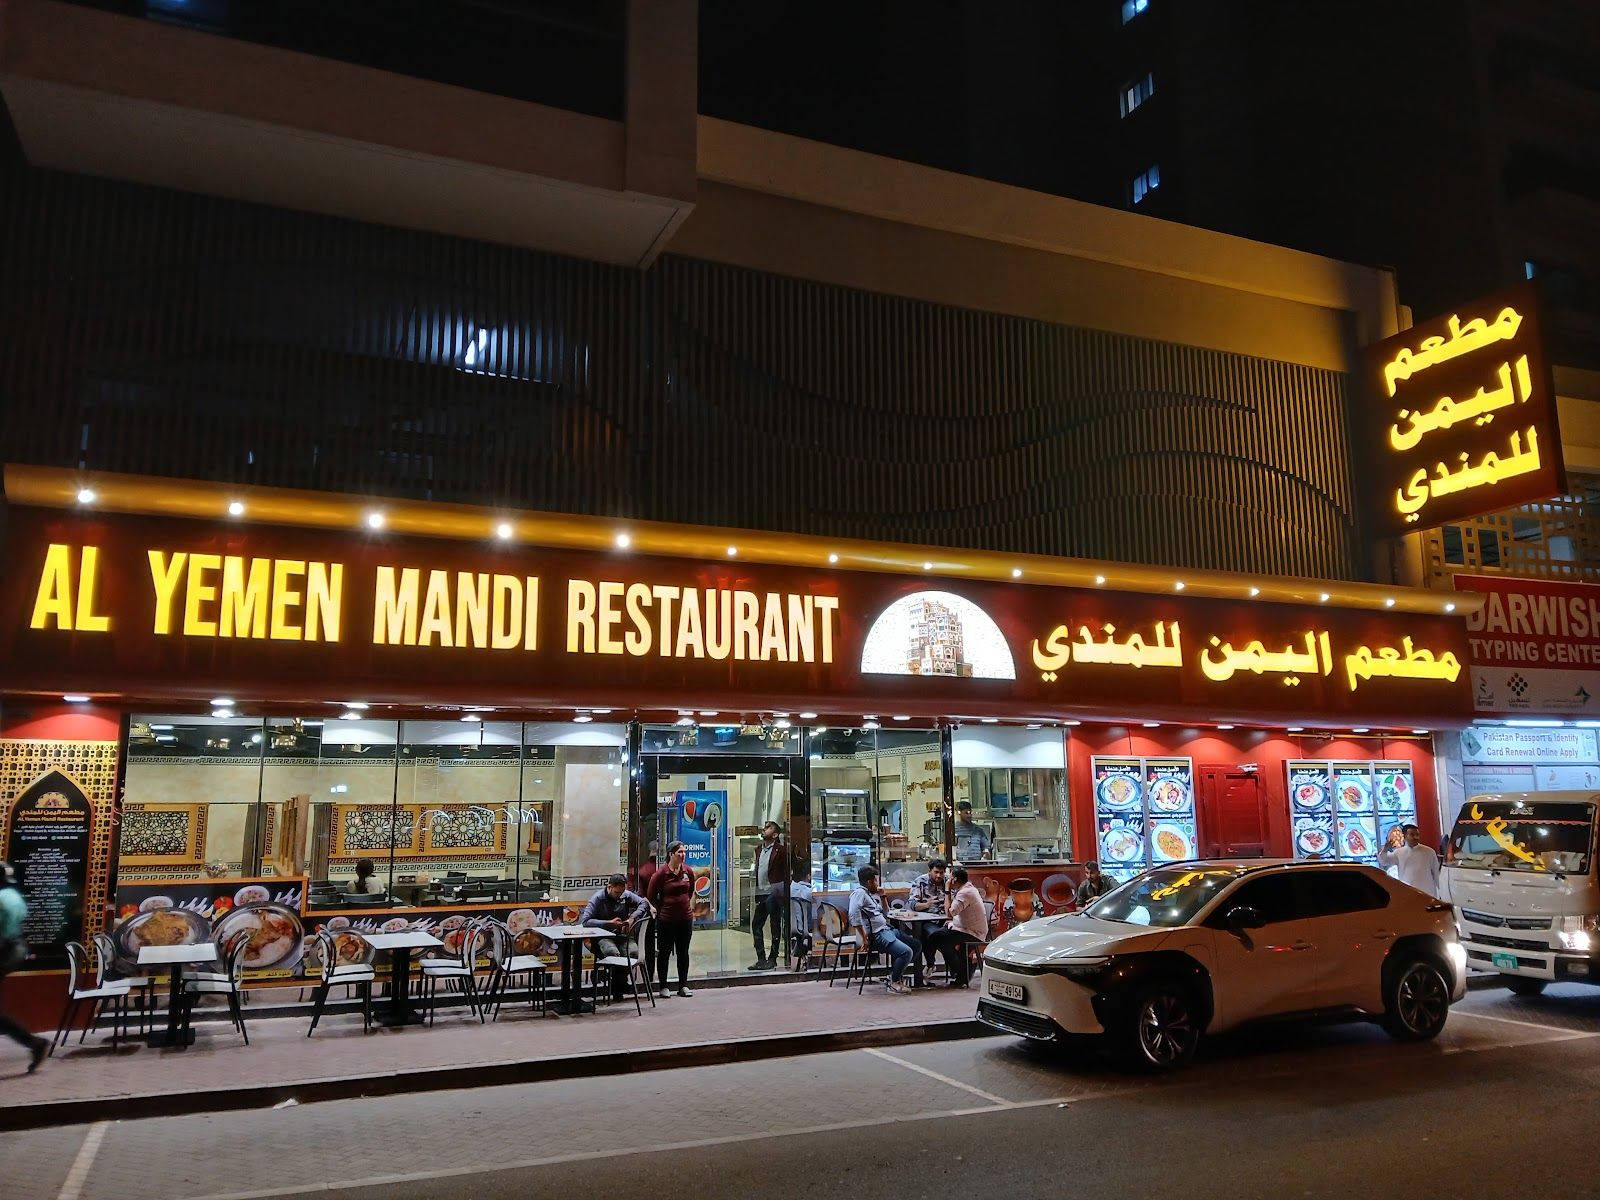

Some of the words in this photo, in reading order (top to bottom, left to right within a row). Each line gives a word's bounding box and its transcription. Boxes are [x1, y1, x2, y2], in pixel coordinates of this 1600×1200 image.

[1385, 307, 1523, 397] مطعم
[1390, 355, 1532, 451] اليمن
[1396, 425, 1541, 522] للمندي
[30, 543, 111, 632] AL
[147, 549, 343, 643] YEMEN
[373, 565, 539, 651] MANDI
[566, 578, 839, 664] RESTAURANT
[1032, 620, 1183, 682] للمندي
[1200, 630, 1333, 687] اليمن
[1345, 636, 1462, 691] مطعم
[1468, 638, 1540, 662] TYPING
[1483, 732, 1514, 743] Pakistan
[1515, 733, 1546, 744] Passport
[1554, 734, 1579, 744] Identity
[1487, 746, 1504, 756] Card
[1505, 747, 1535, 757] Renewal
[1536, 748, 1558, 757] Online
[1560, 748, 1579, 758] Apply
[688, 851, 711, 860] ENJOY.
